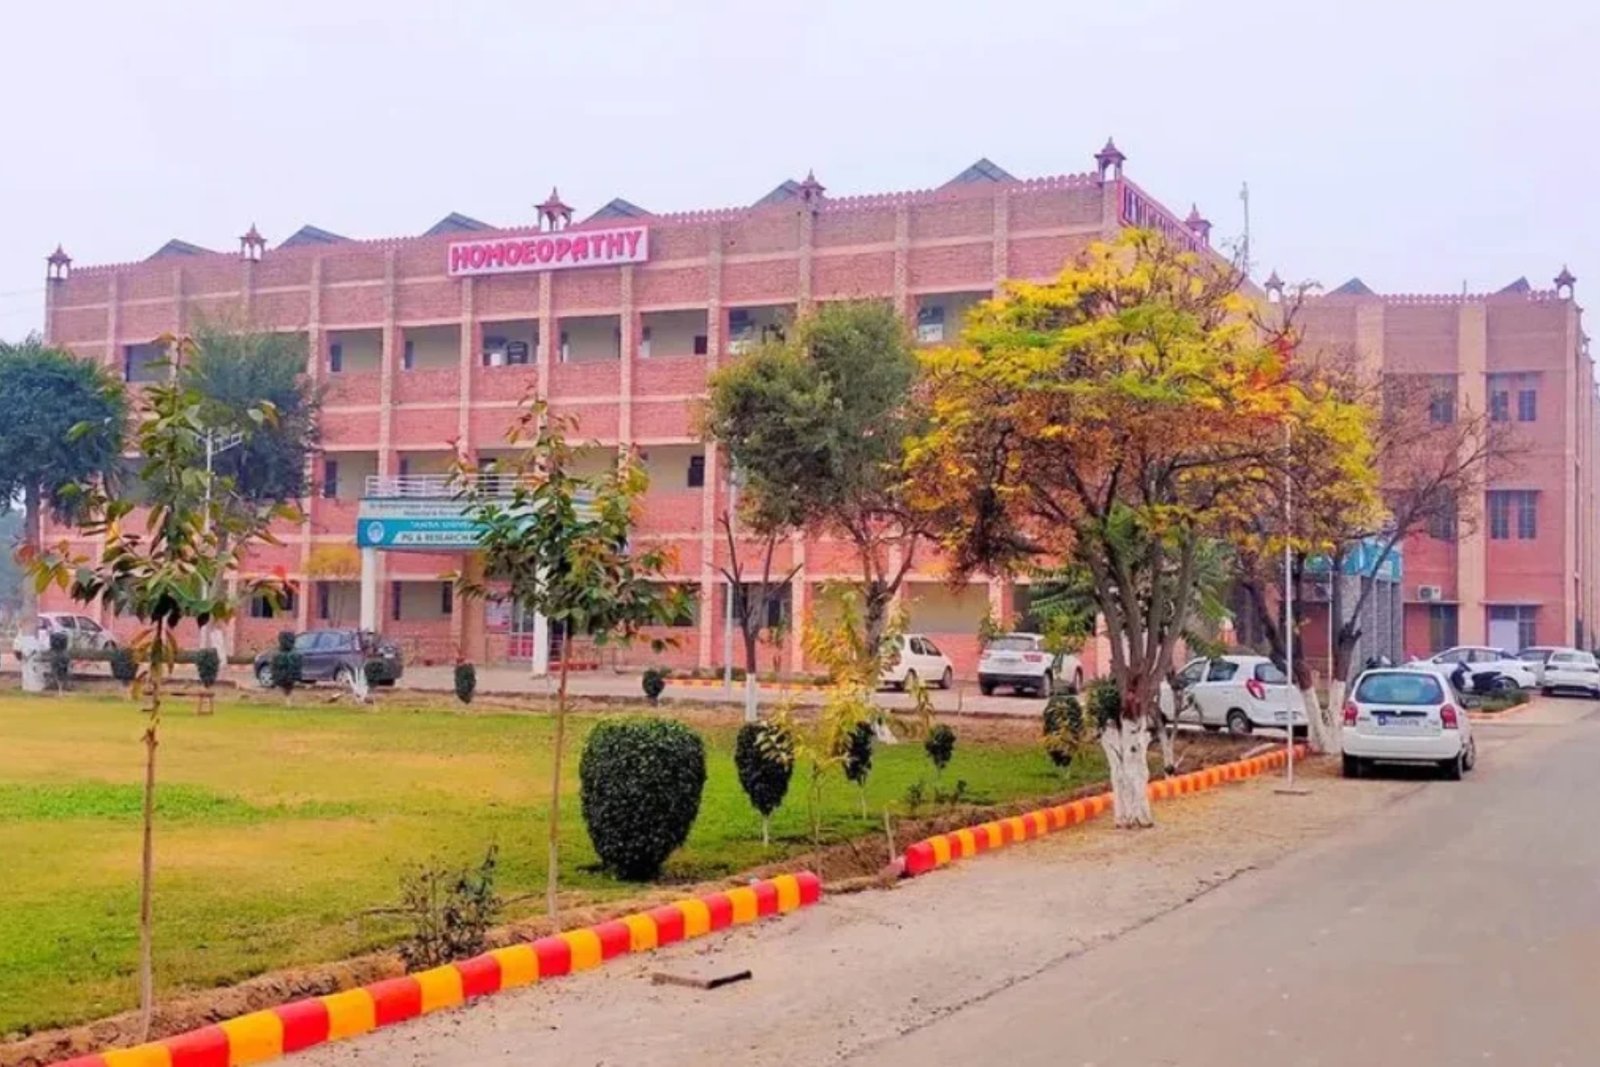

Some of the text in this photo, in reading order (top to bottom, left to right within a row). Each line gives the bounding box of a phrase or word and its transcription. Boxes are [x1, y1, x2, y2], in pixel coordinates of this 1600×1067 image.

[451, 231, 643, 271] HOMOEOPATHY
[401, 532, 414, 542] PG
[425, 532, 468, 542] RESEARCH
